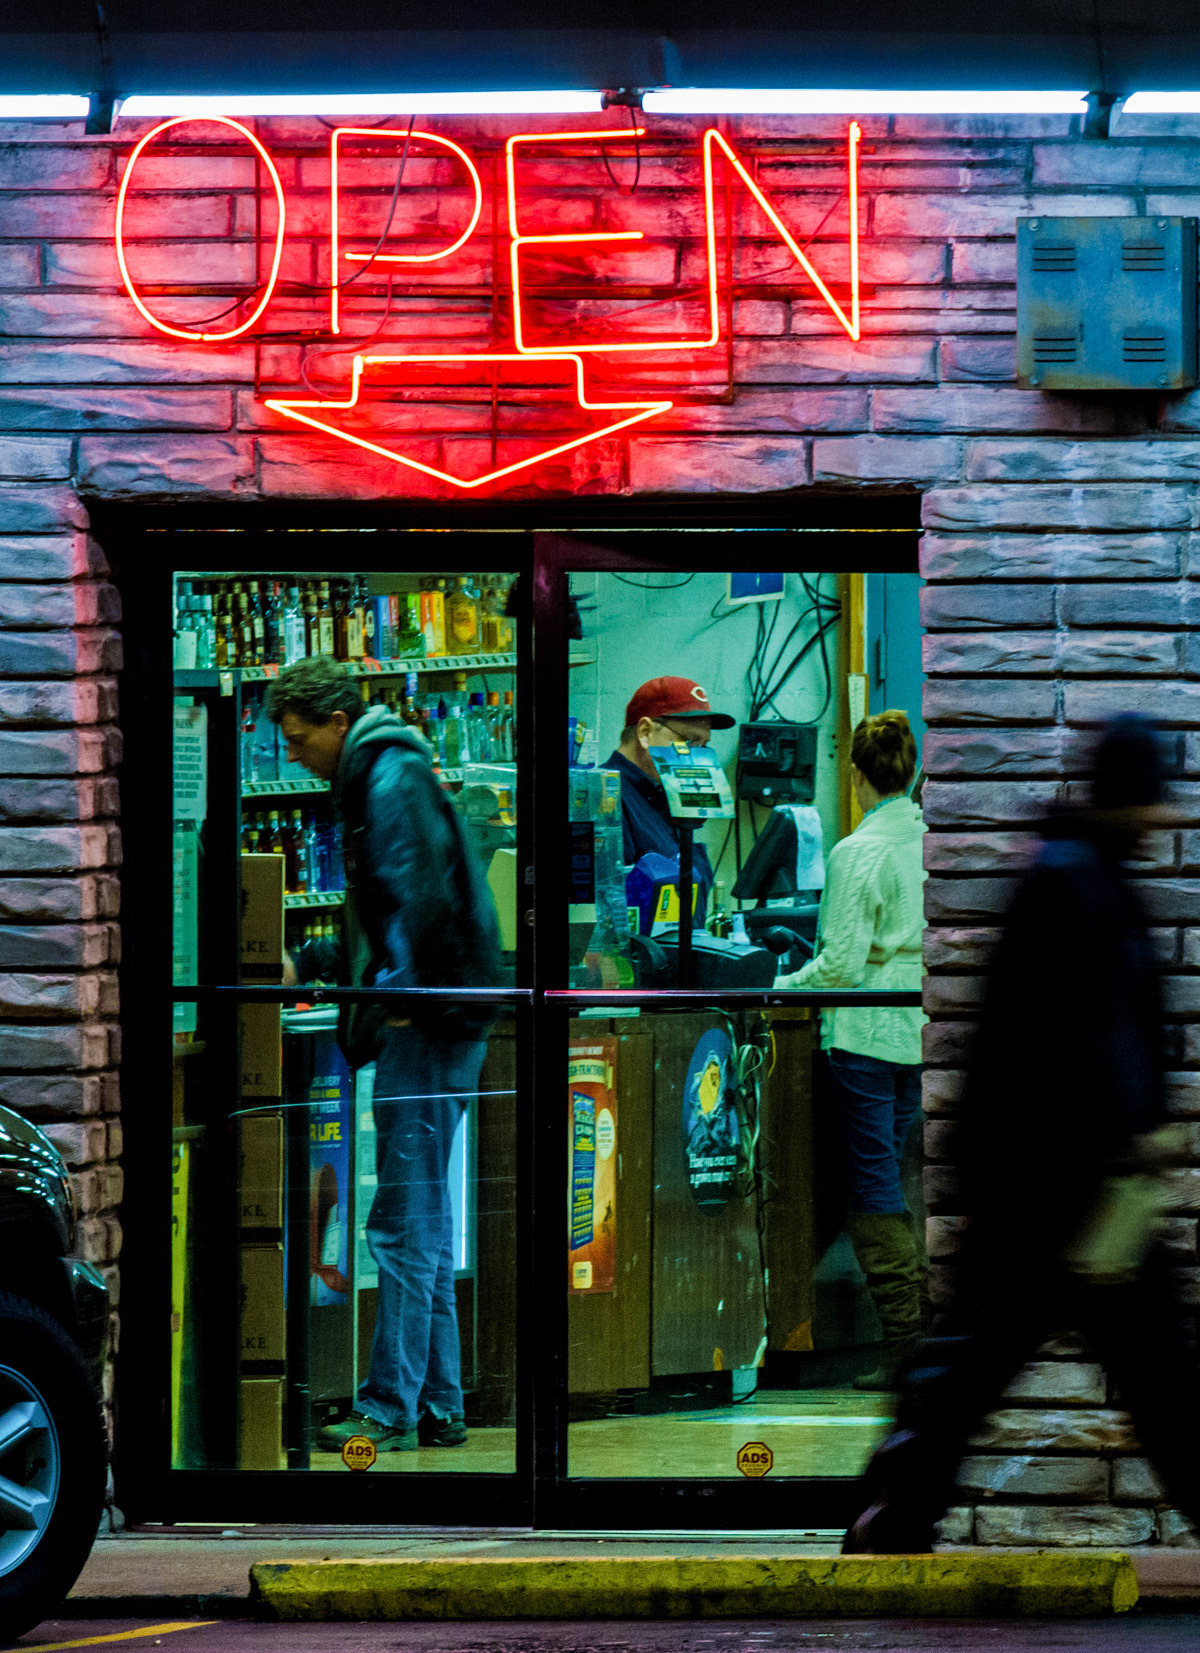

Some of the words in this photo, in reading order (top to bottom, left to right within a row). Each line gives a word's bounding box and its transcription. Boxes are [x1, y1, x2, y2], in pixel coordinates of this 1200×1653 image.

[115, 114, 864, 352] OPEN
[346, 1446, 372, 1456] ADS
[741, 1453, 768, 1464] ADS
